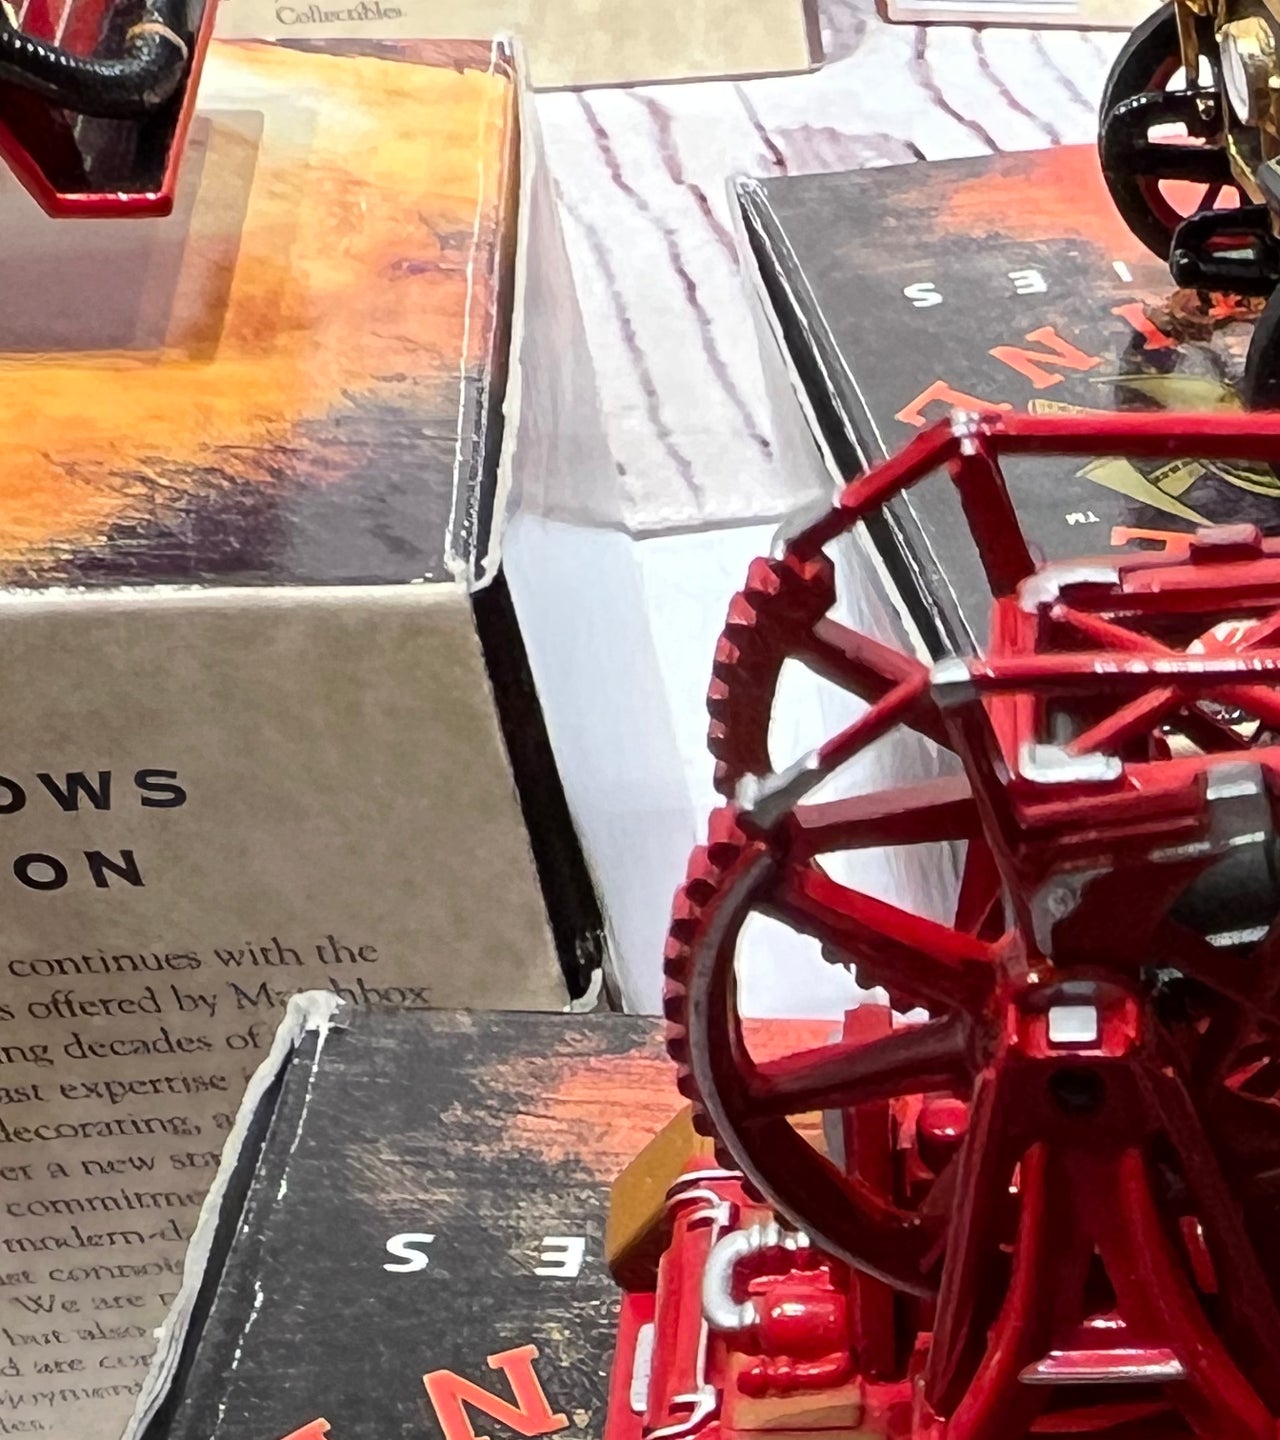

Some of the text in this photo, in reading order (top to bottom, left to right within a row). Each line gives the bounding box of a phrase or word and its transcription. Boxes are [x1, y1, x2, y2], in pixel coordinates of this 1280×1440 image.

[8, 934, 380, 978] continues with the
[28, 985, 162, 1021] offered
[170, 983, 218, 1018] by
[64, 1031, 210, 1060] decades
[226, 1023, 269, 1050] of
[59, 1072, 229, 1105] expertise
